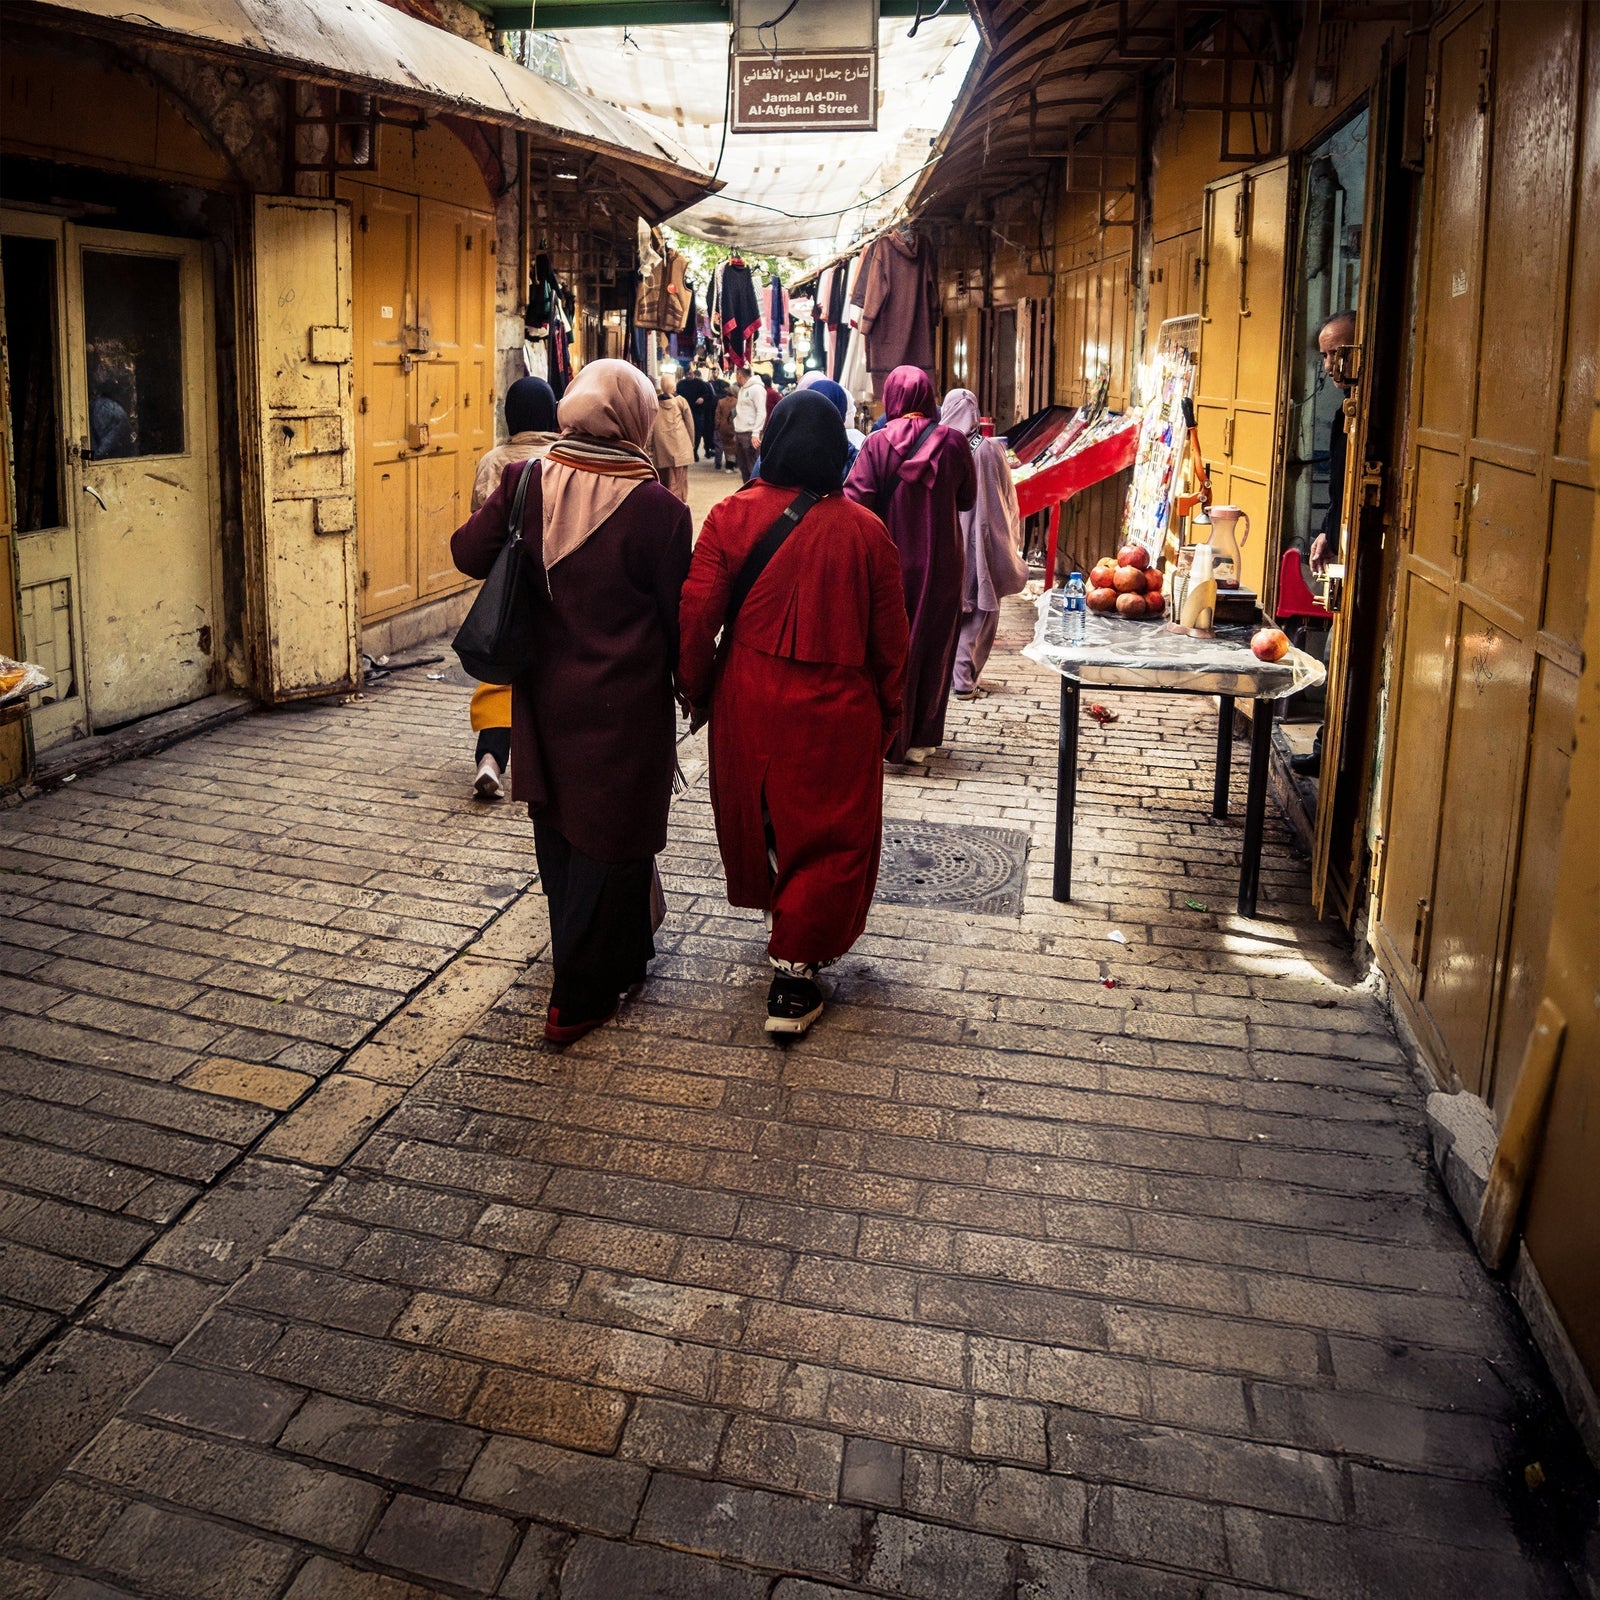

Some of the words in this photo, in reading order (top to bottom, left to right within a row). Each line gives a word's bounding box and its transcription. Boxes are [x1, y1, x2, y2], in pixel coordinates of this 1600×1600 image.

[785, 68, 814, 83] الدين
[815, 68, 842, 82] جمال
[845, 65, 869, 81] شارع
[762, 92, 800, 103] Jamal
[805, 91, 847, 102] Ad-Din
[748, 105, 814, 117] Al-Afghani
[818, 103, 859, 114] Street
